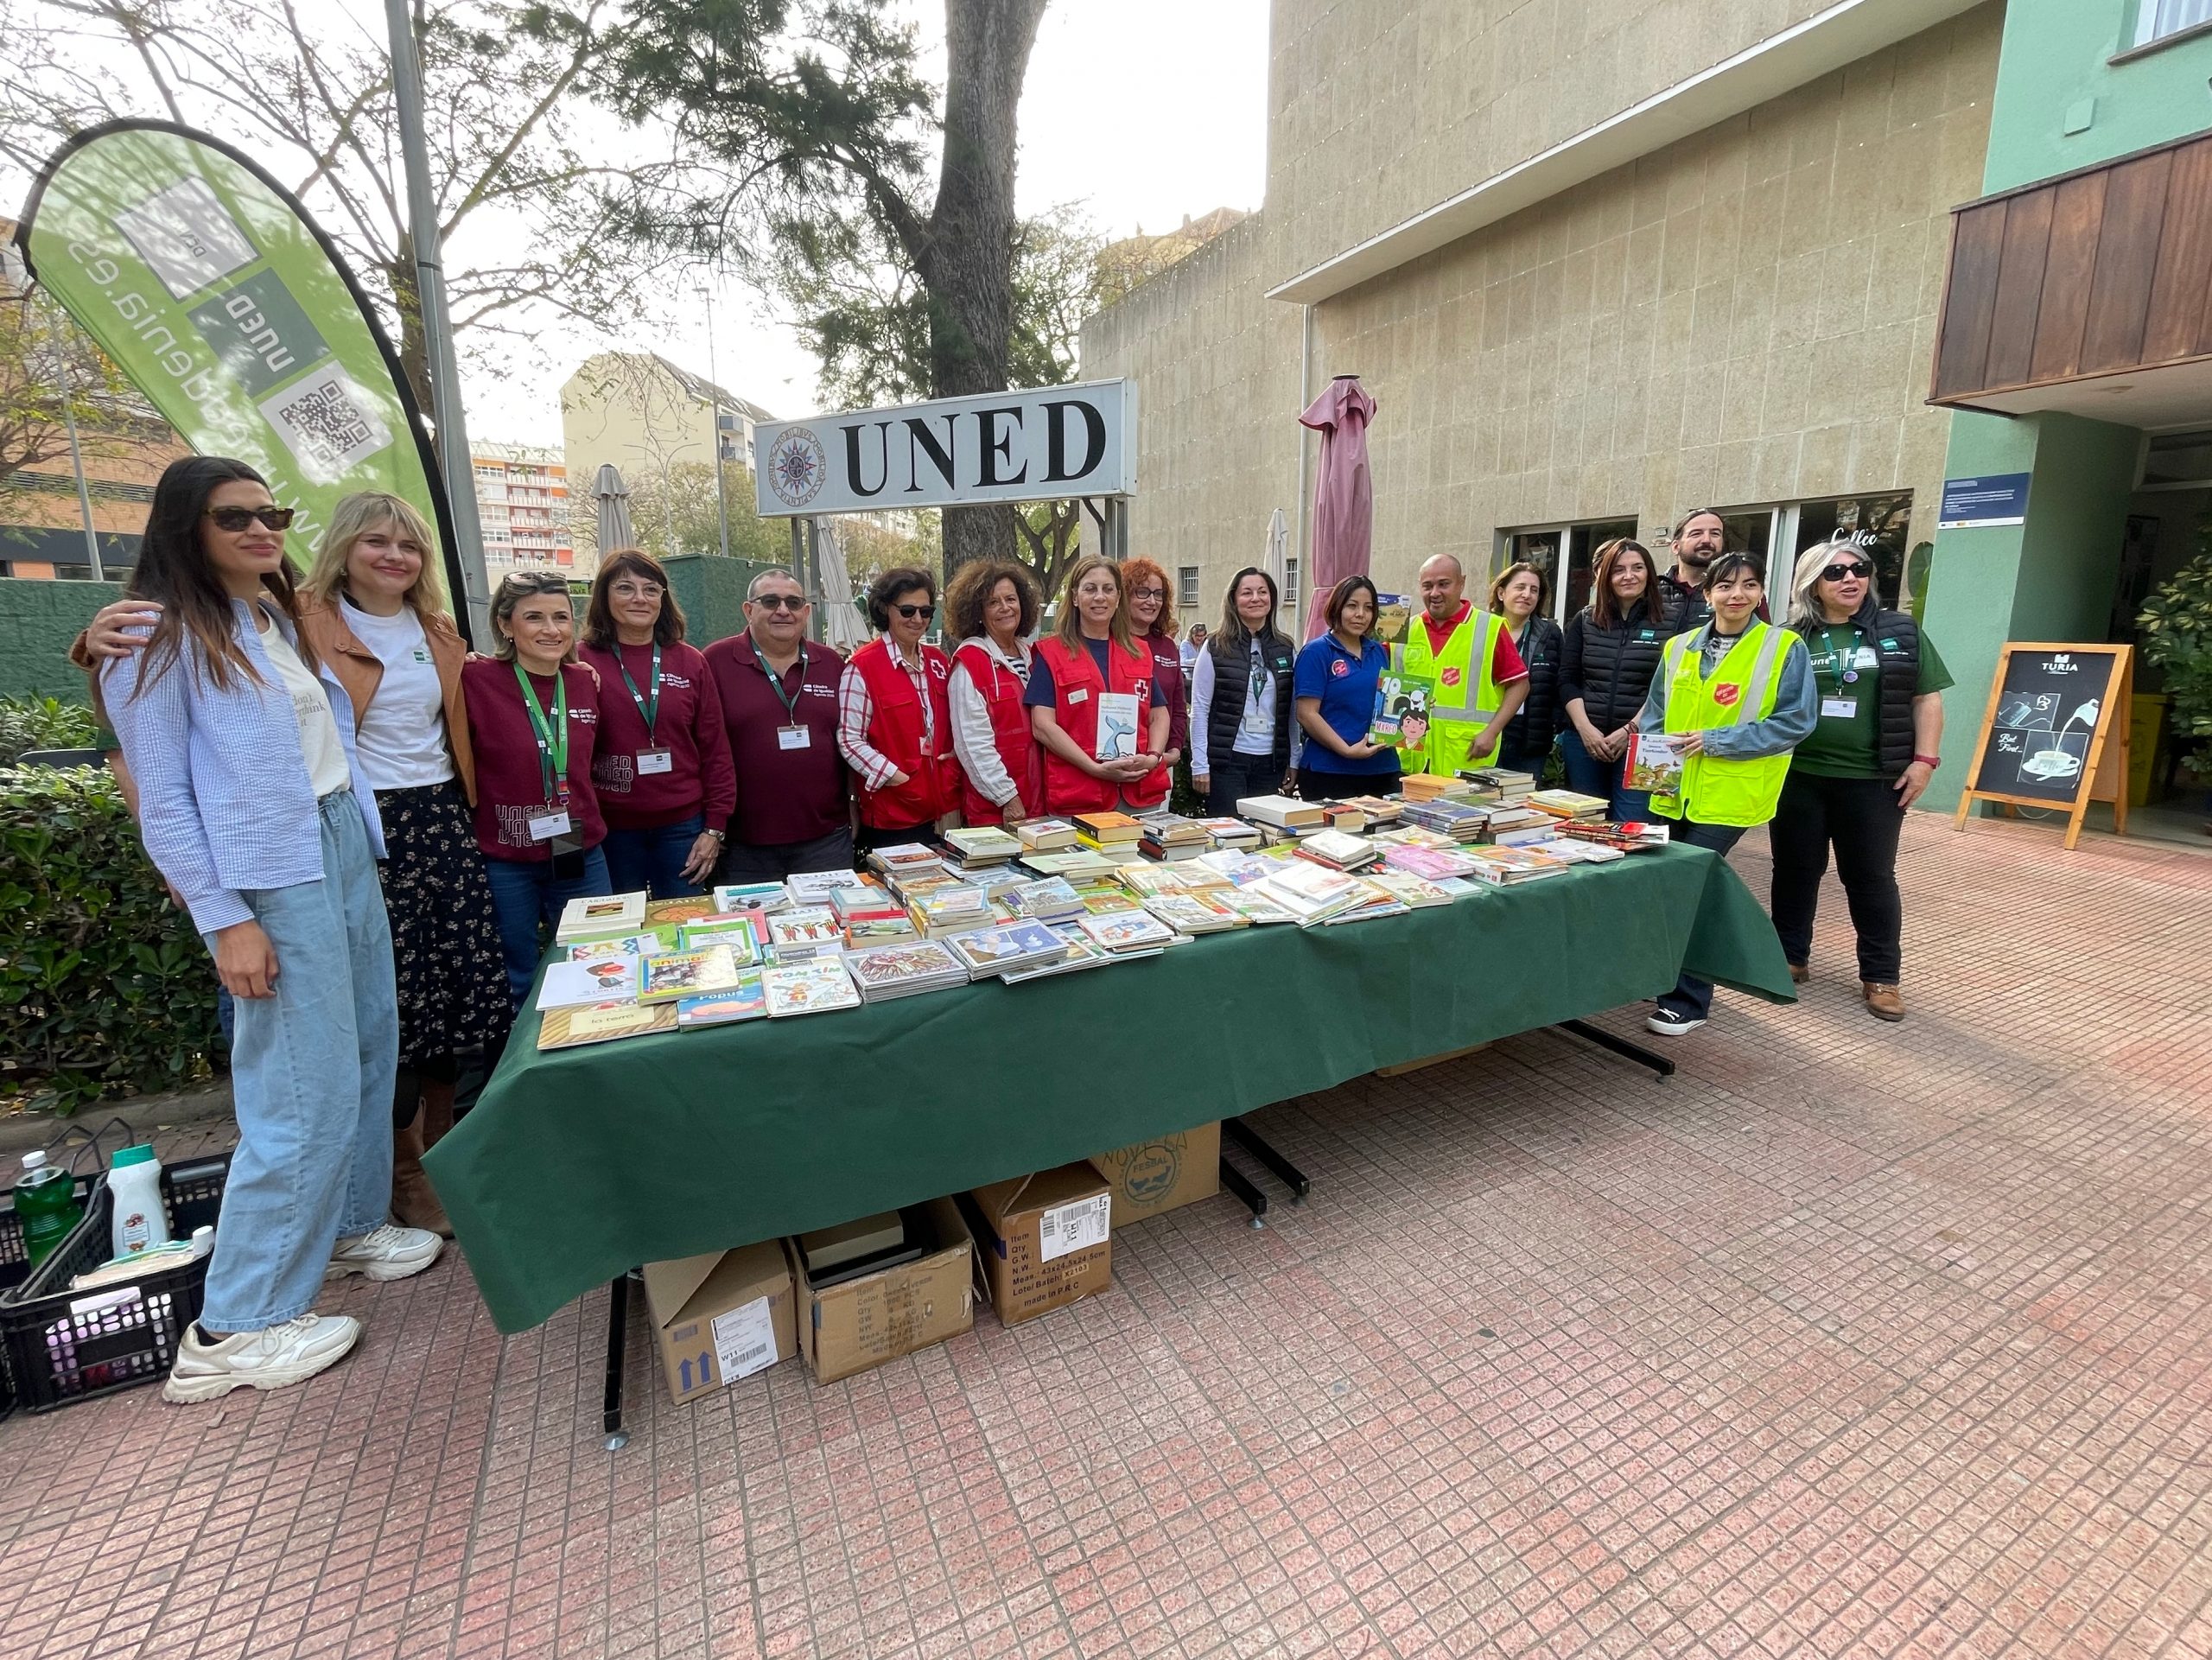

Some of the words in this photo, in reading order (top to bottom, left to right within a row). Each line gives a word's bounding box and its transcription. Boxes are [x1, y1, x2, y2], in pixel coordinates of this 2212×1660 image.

[839, 400, 1107, 497] UNED
[2042, 663, 2078, 671] TURIA
[1382, 677, 1401, 696] 10
[301, 718, 308, 727] it
[1134, 1157, 1167, 1173] FESBAL
[1011, 1233, 1029, 1243] Item
[1012, 1245, 1026, 1254] Qty
[1064, 1265, 1088, 1277] X2103
[1024, 1295, 1046, 1307] made
[858, 1307, 871, 1315] Qty
[721, 1350, 738, 1362] W11
